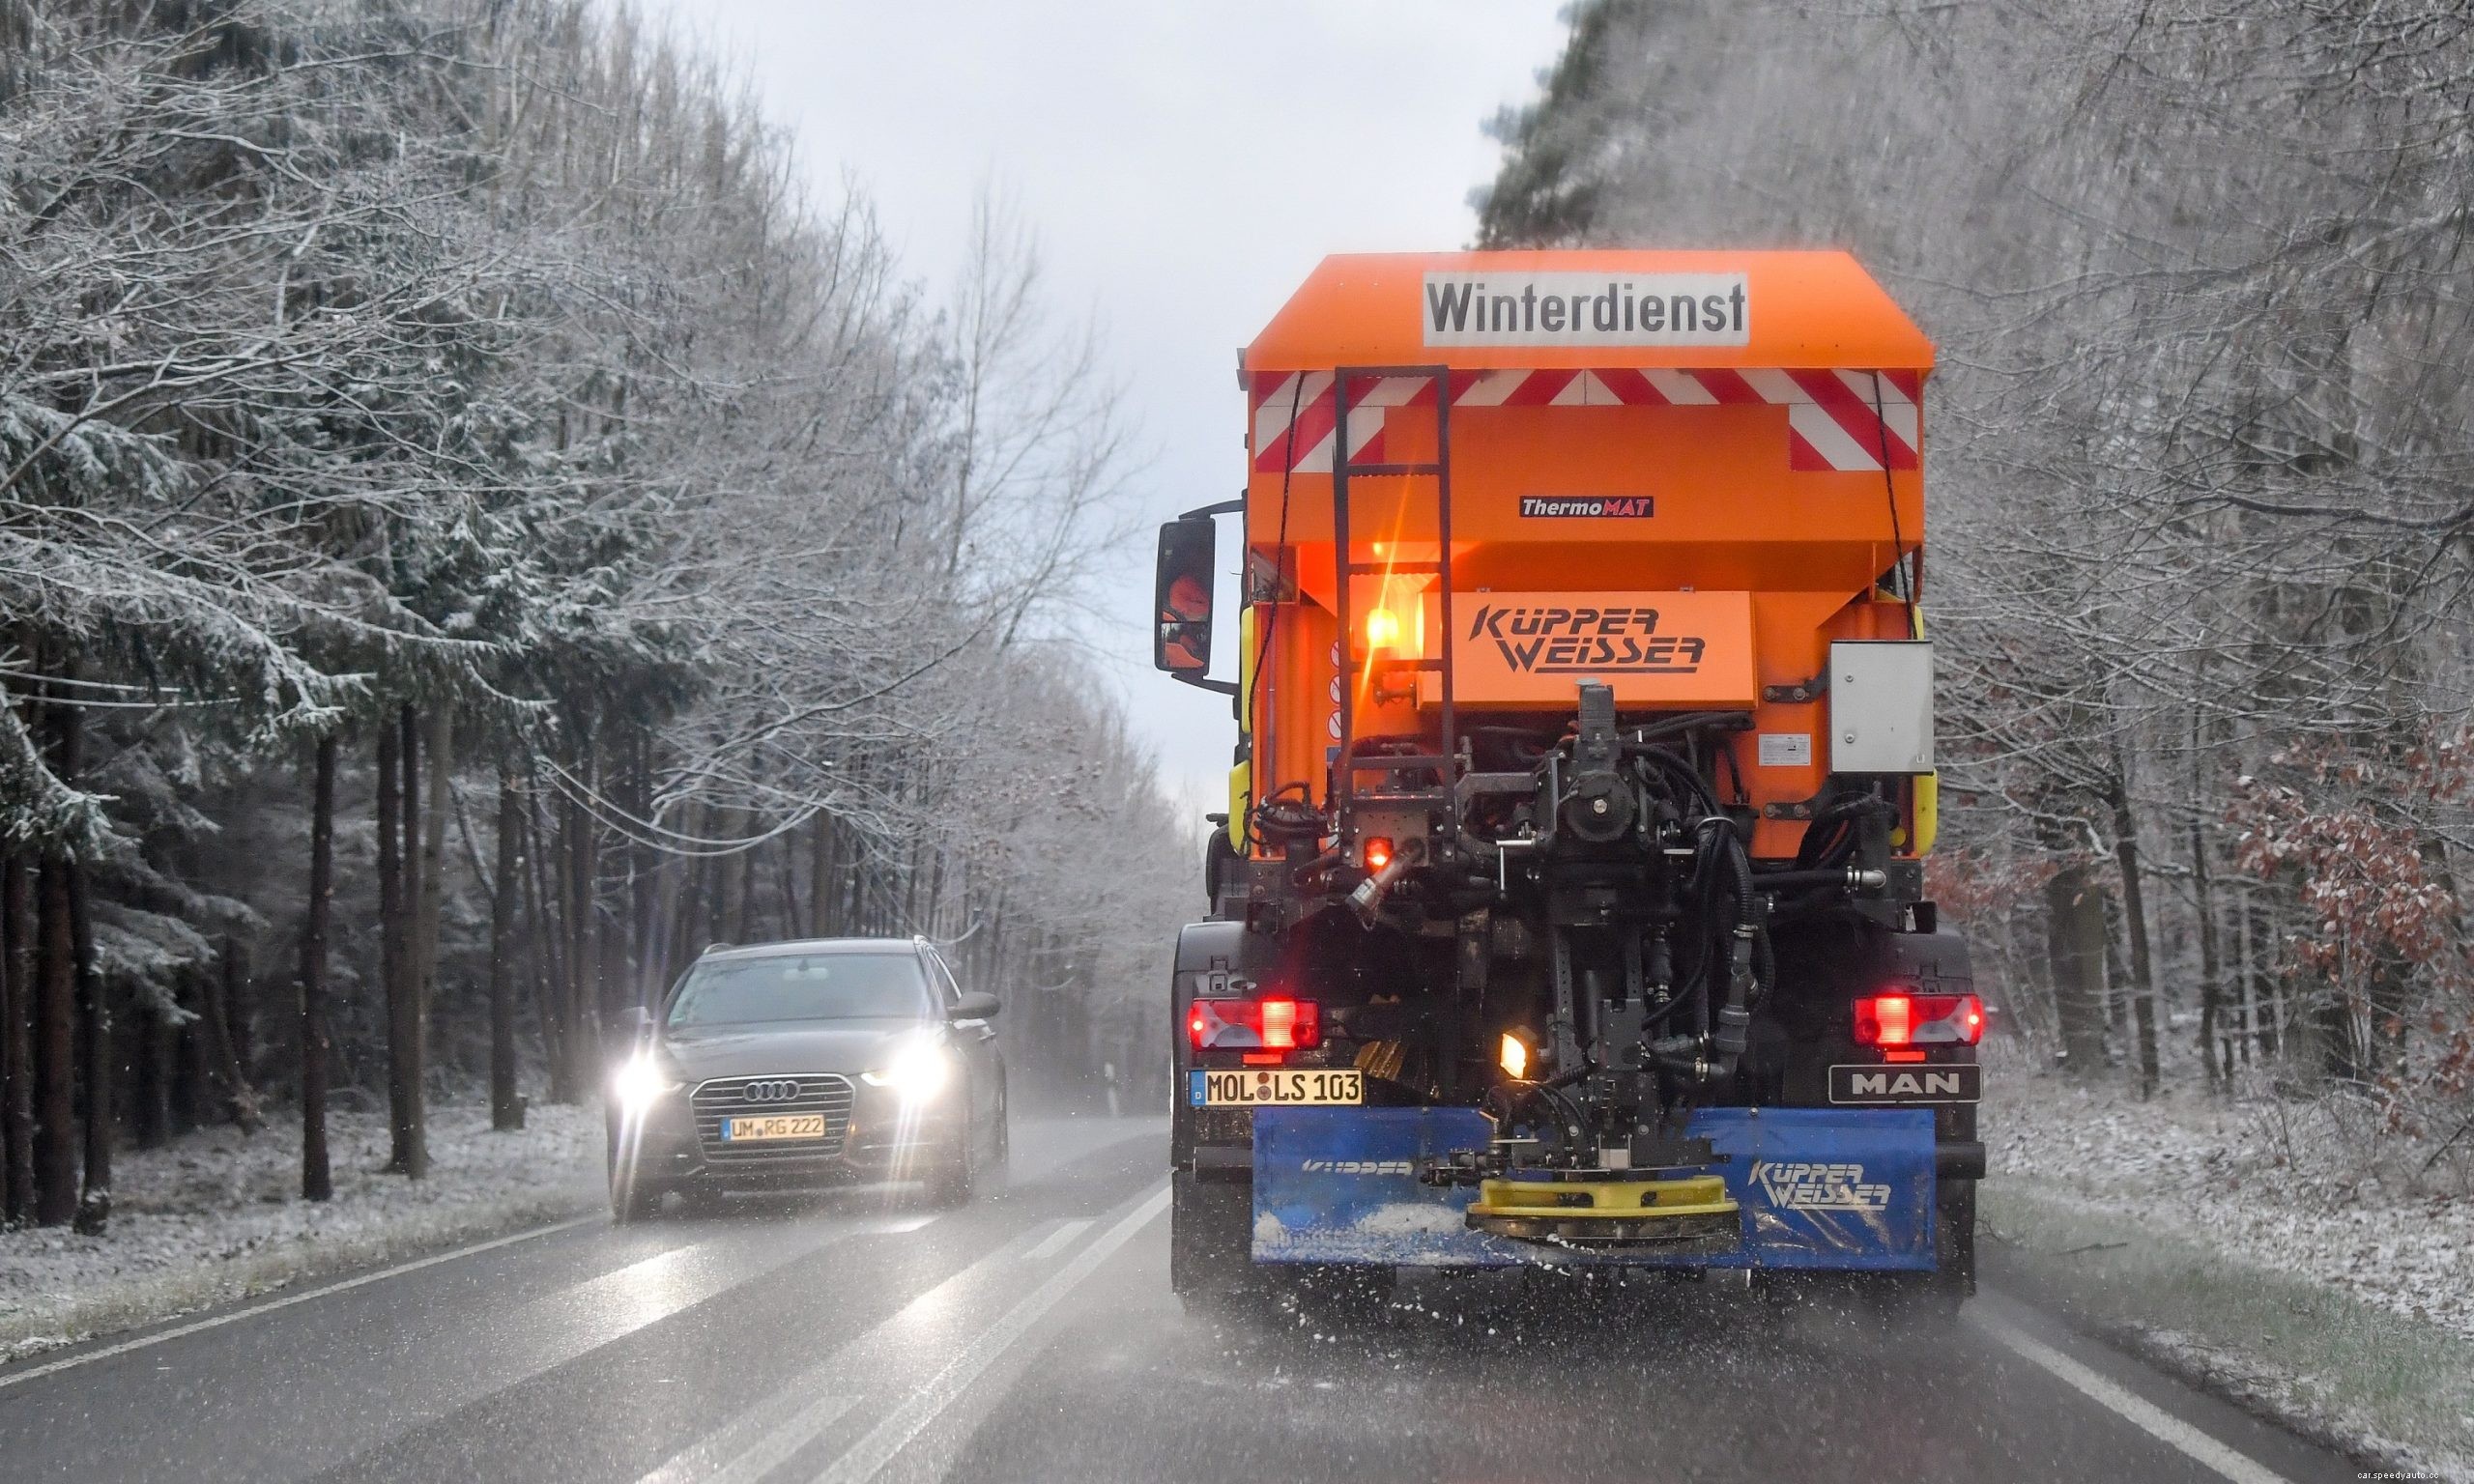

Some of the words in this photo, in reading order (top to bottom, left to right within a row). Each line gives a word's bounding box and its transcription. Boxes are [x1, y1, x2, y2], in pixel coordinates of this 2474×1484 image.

[1426, 283, 1745, 331] Winterdienst
[1523, 499, 1650, 516] ThermoMAT
[1469, 604, 1659, 641] KÜPPER
[1495, 637, 1706, 672] WEISSER
[1208, 1074, 1254, 1101] MOL
[1275, 1074, 1305, 1100] LS
[1313, 1073, 1360, 1100] 103
[1852, 1072, 1960, 1094] MAN
[732, 1121, 754, 1137] UM
[764, 1119, 787, 1135] RG
[791, 1118, 822, 1134] 222
[1747, 1159, 1864, 1185] KÜPPER
